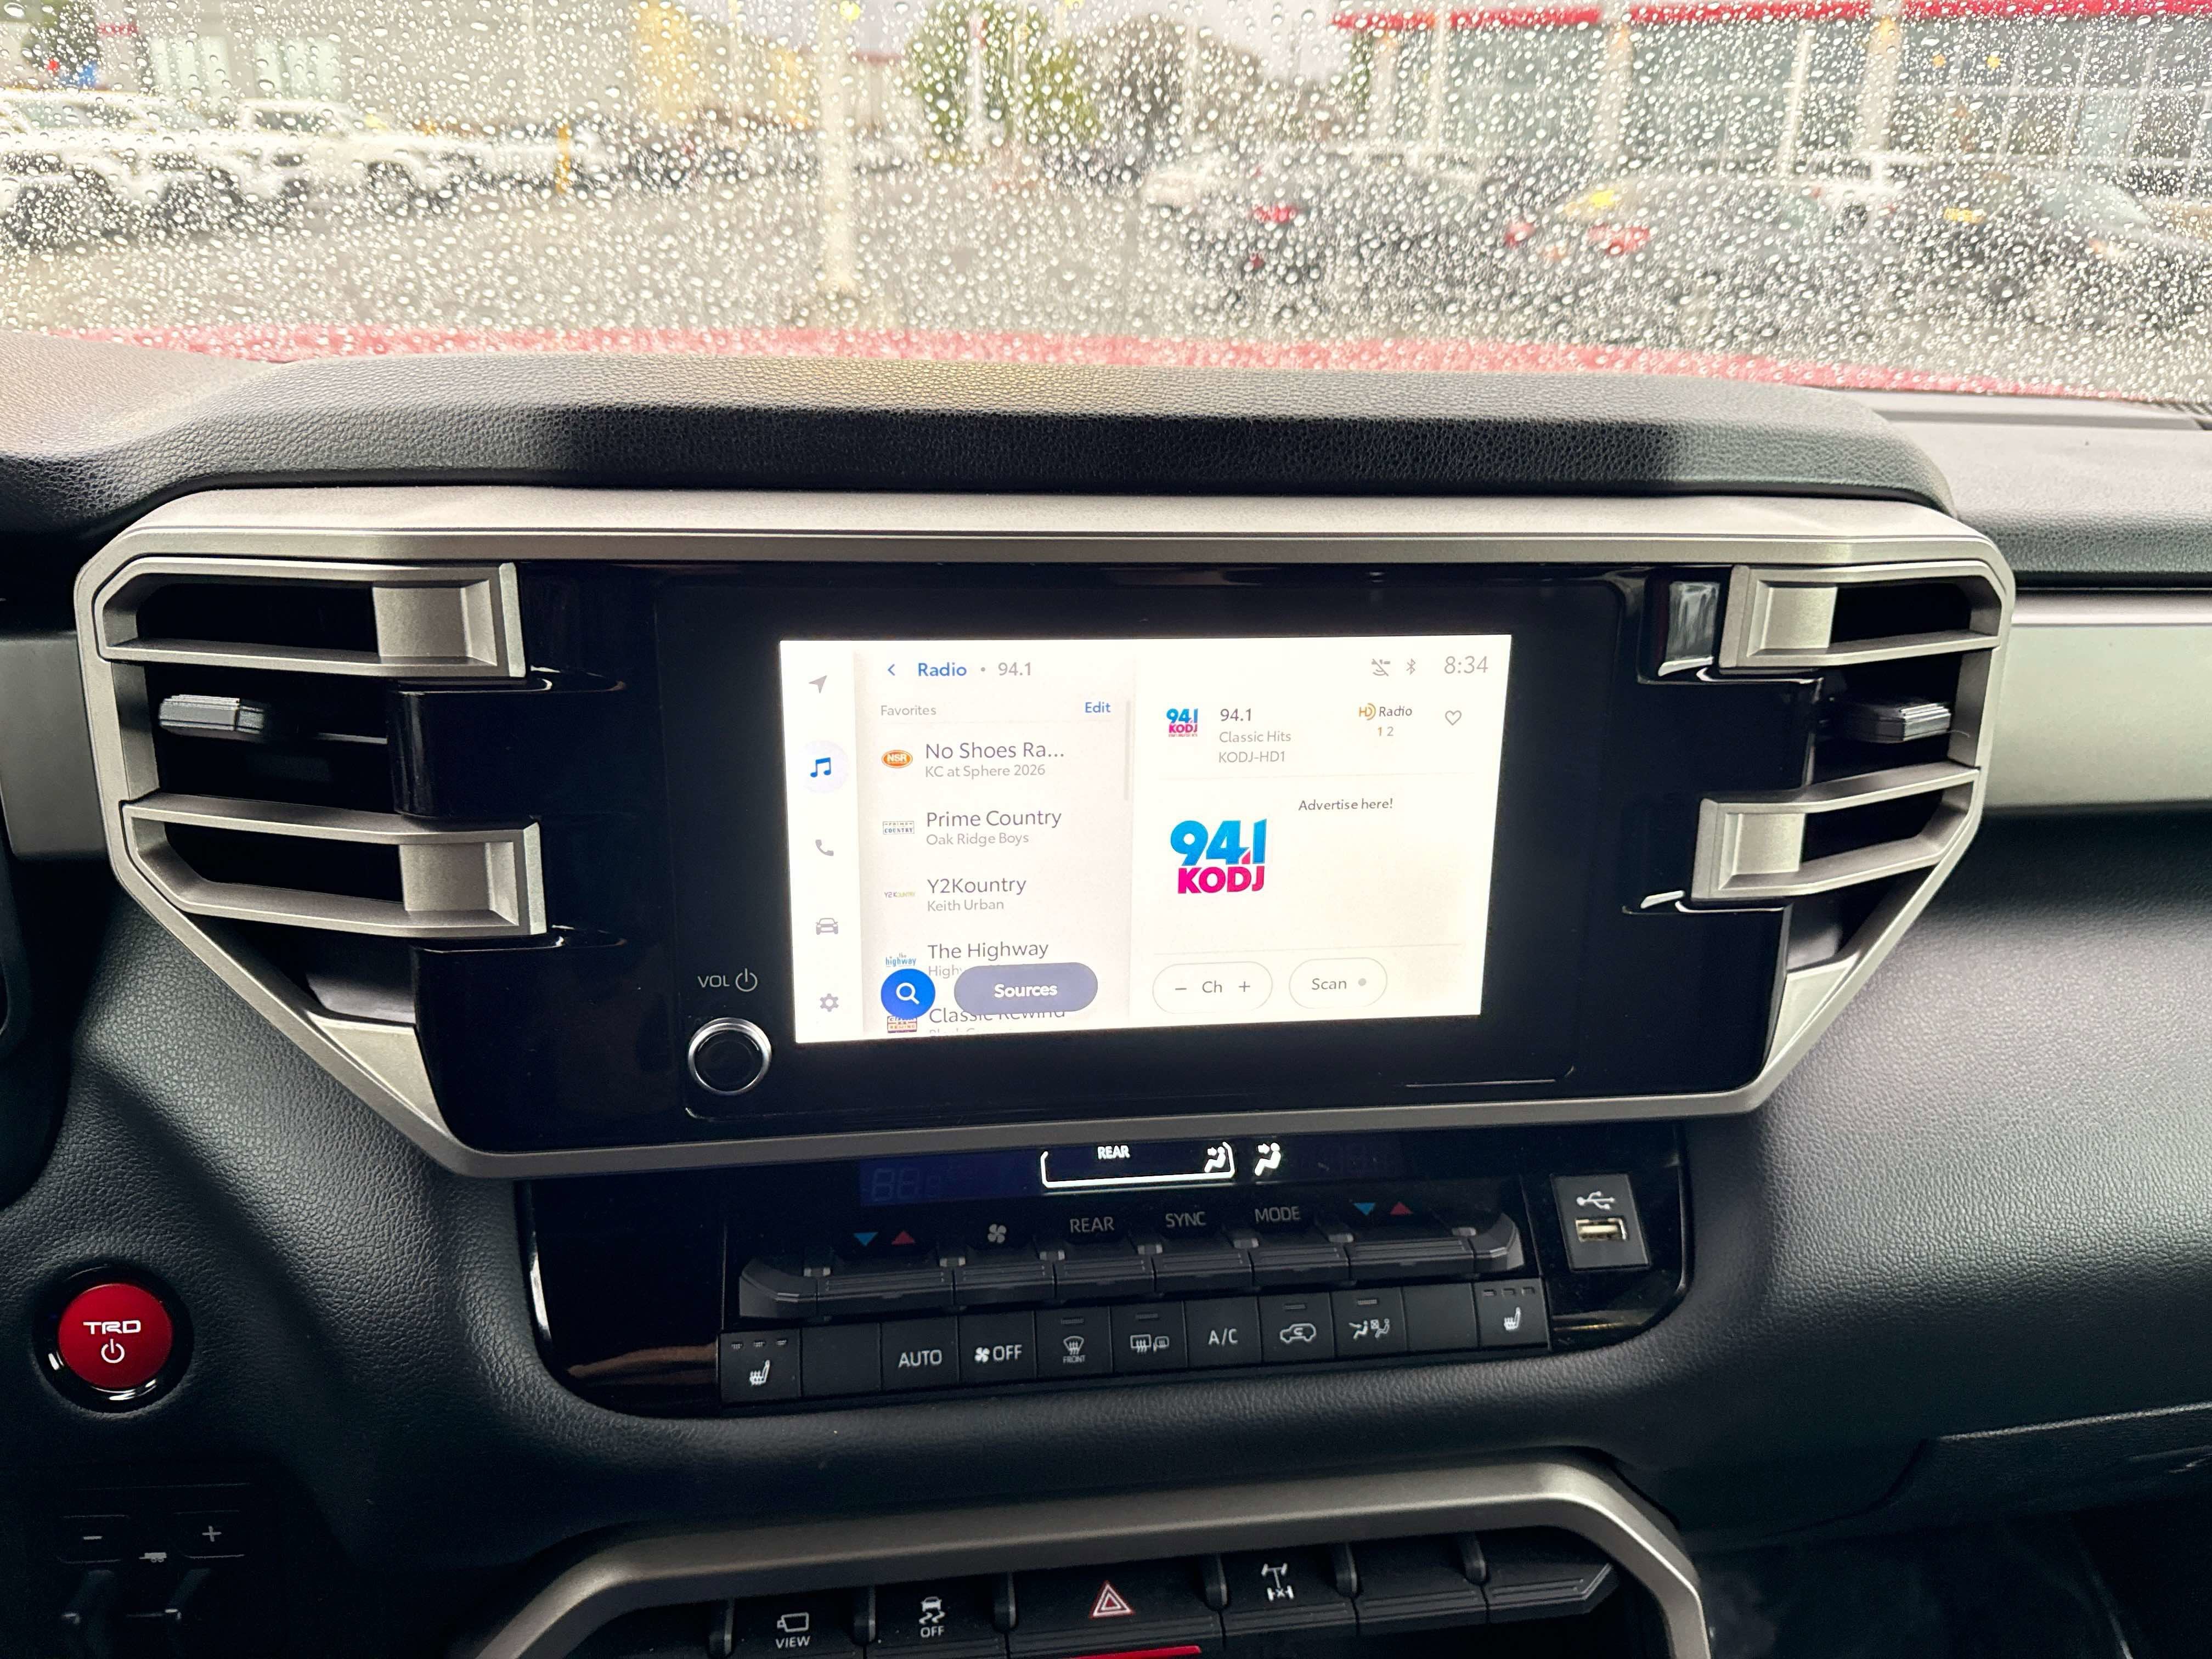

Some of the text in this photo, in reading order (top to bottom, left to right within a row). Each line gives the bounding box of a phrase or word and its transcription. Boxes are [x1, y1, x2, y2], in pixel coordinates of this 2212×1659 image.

[918, 662, 1031, 676] Radio 94.1
[1444, 655, 1488, 674] 8:34
[881, 705, 936, 716] Favorites
[1085, 701, 1111, 713] Edit
[1379, 705, 1413, 717] Radio
[1220, 708, 1251, 722] 94.1
[1169, 724, 1198, 733] KODJ
[1378, 726, 1394, 737] 1 2
[1219, 730, 1291, 743] Classic Hits
[926, 742, 1064, 759] No Shoes Ra...
[1218, 751, 1285, 763] KODJ-HD1
[886, 753, 907, 763] NSR
[926, 764, 1046, 780] KC at Sphere 2026
[1298, 798, 1393, 811] Advertise here!
[927, 810, 1062, 828] Prime Country
[926, 832, 1029, 848] Oak Ridge Boys
[1170, 818, 1267, 866] 94.1
[927, 877, 1026, 896] Y2Kountry
[1177, 865, 1265, 894] KODJ
[927, 898, 1004, 912] Keith Urban
[927, 941, 1049, 962] The Highway
[885, 956, 917, 967] highway
[697, 975, 730, 988] VOL
[1202, 980, 1222, 993] Ch
[1311, 978, 1347, 990] Scan
[994, 983, 1058, 998] Sources
[1097, 1145, 1130, 1160] REAR
[1165, 1211, 1206, 1228] SYNC
[1254, 1206, 1301, 1222] MODE
[1069, 1216, 1115, 1233] REAR
[83, 1320, 141, 1335] TRD
[1208, 1328, 1238, 1345] A/C
[898, 1349, 943, 1368] AUTO
[992, 1344, 1022, 1361] OFF
[1063, 1355, 1086, 1364] FRONT
[920, 1625, 945, 1638] OFF
[775, 1635, 810, 1649] VIEW
